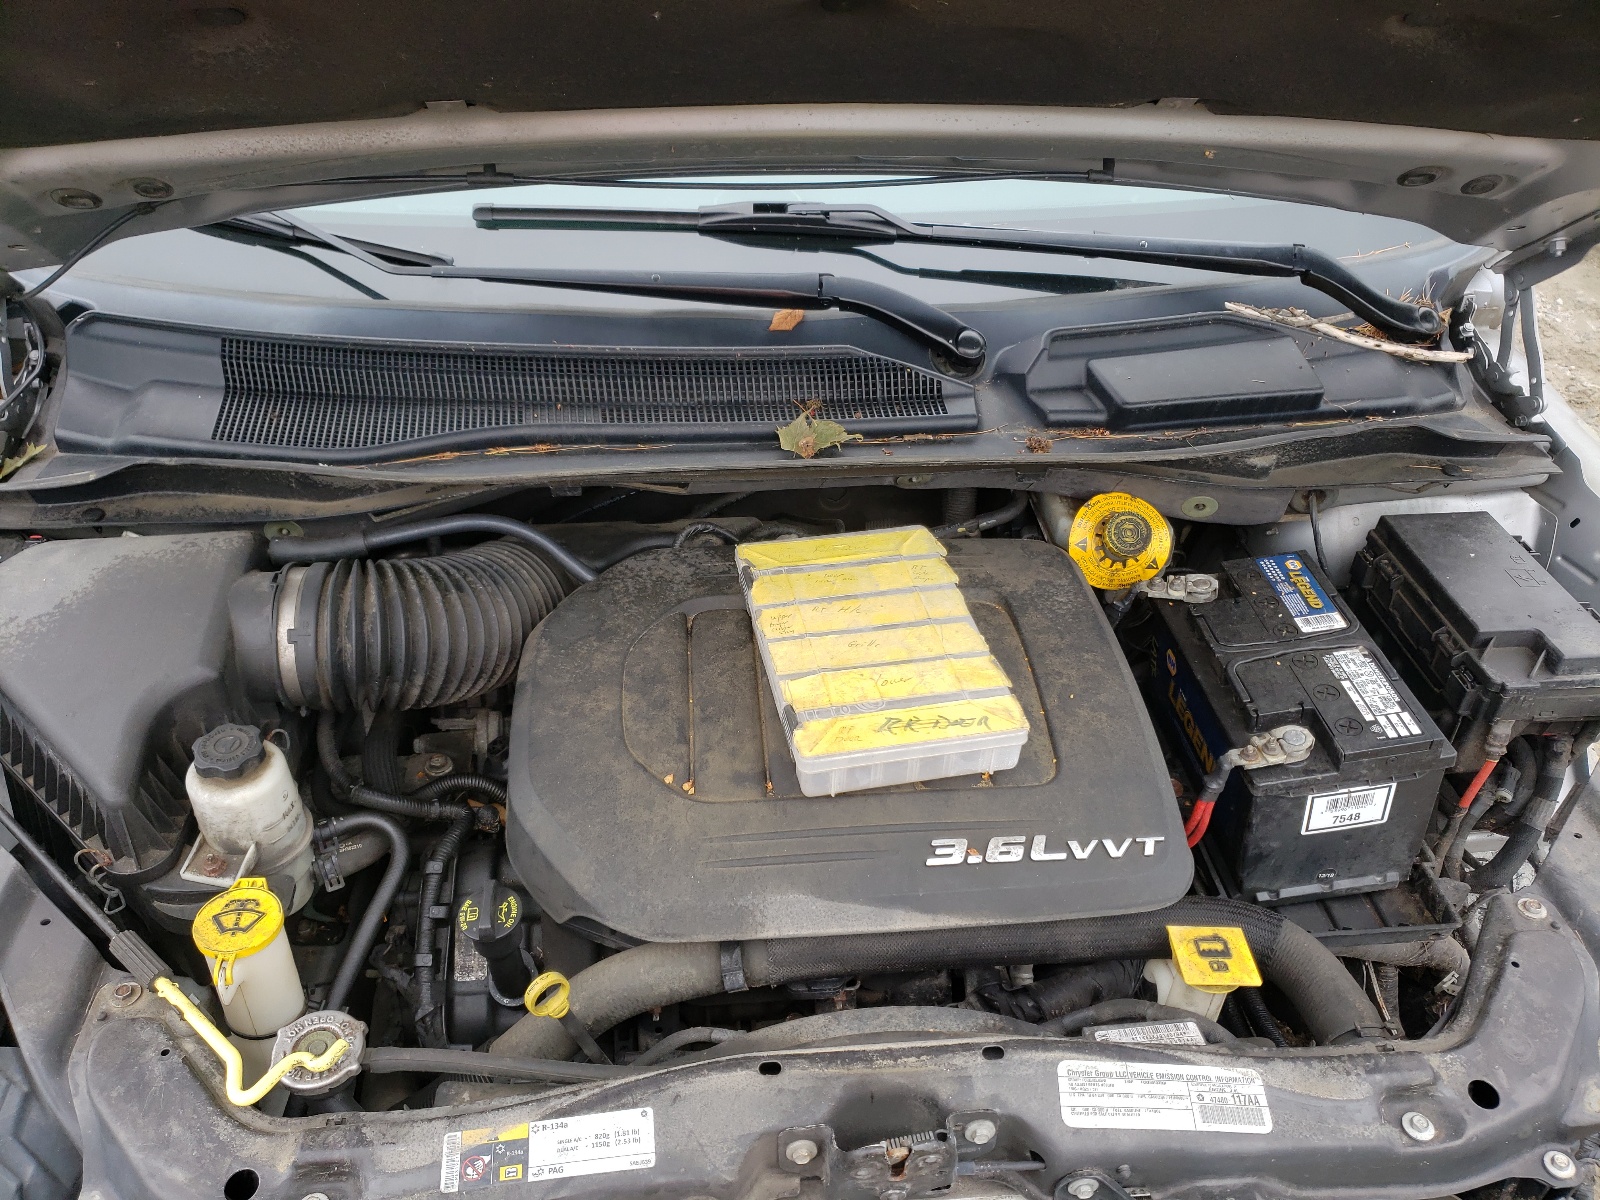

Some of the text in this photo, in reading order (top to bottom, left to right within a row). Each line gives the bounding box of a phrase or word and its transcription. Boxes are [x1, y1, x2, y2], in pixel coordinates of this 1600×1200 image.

[1287, 571, 1324, 609] LEGEND
[1168, 680, 1217, 775] LEGEN
[1331, 812, 1361, 825] 7548
[503, 895, 518, 929] ENGINE OIL
[304, 1015, 335, 1028] OPEN
[335, 1018, 355, 1036] NOT
[284, 1022, 304, 1044] HOT
[1067, 1068, 1257, 1084] Chrysler Group LLC VEHICLE EMISSION CONTROL INFORMATION
[541, 1121, 569, 1132] R-134a
[594, 1132, 611, 1141] 820g
[591, 1140, 611, 1149] 1150g
[548, 1165, 564, 1175] PAG
